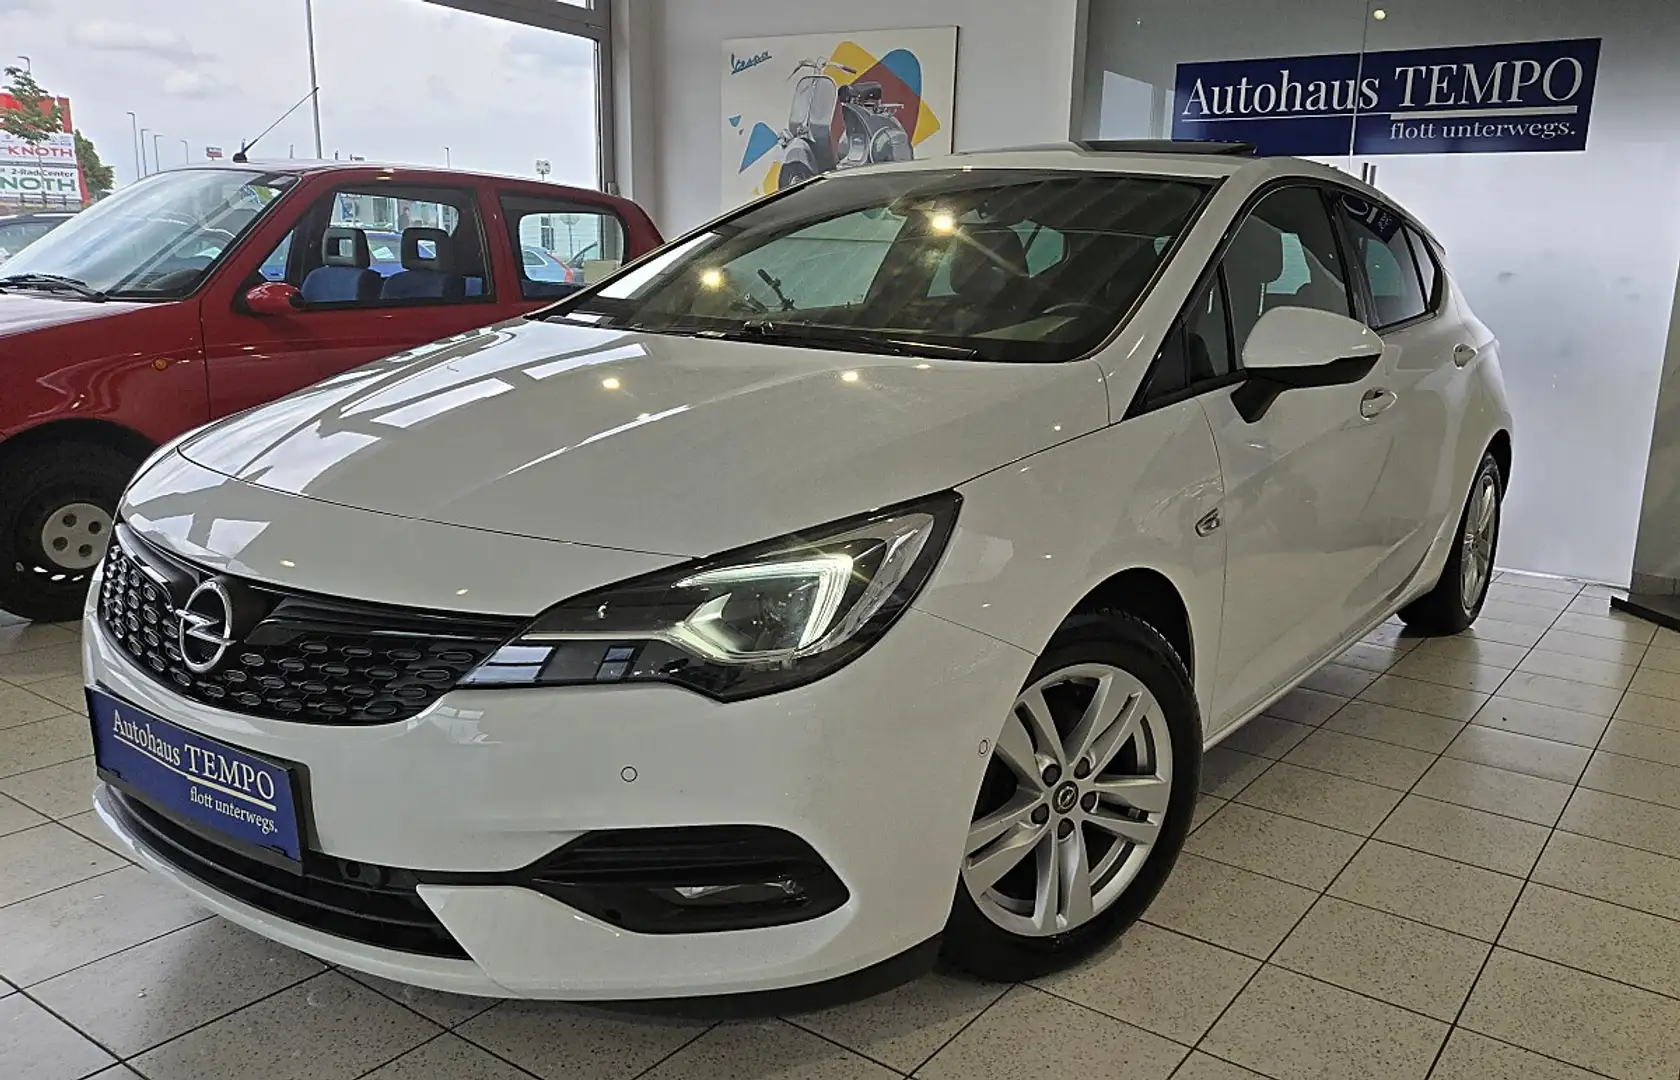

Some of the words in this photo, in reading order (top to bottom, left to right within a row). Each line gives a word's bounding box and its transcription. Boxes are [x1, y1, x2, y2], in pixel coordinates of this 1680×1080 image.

[731, 51, 773, 75] Vespa
[1182, 69, 1379, 115] Autohaus
[1394, 57, 1584, 106] TEMPO
[1390, 123, 1436, 140] flott
[1442, 121, 1577, 138] unterwegs.
[8, 146, 73, 157] KNOTH
[112, 709, 181, 766] Autohaus
[184, 744, 275, 800] TEMPO
[190, 786, 213, 808] flott
[215, 800, 278, 835] unterwegs.
